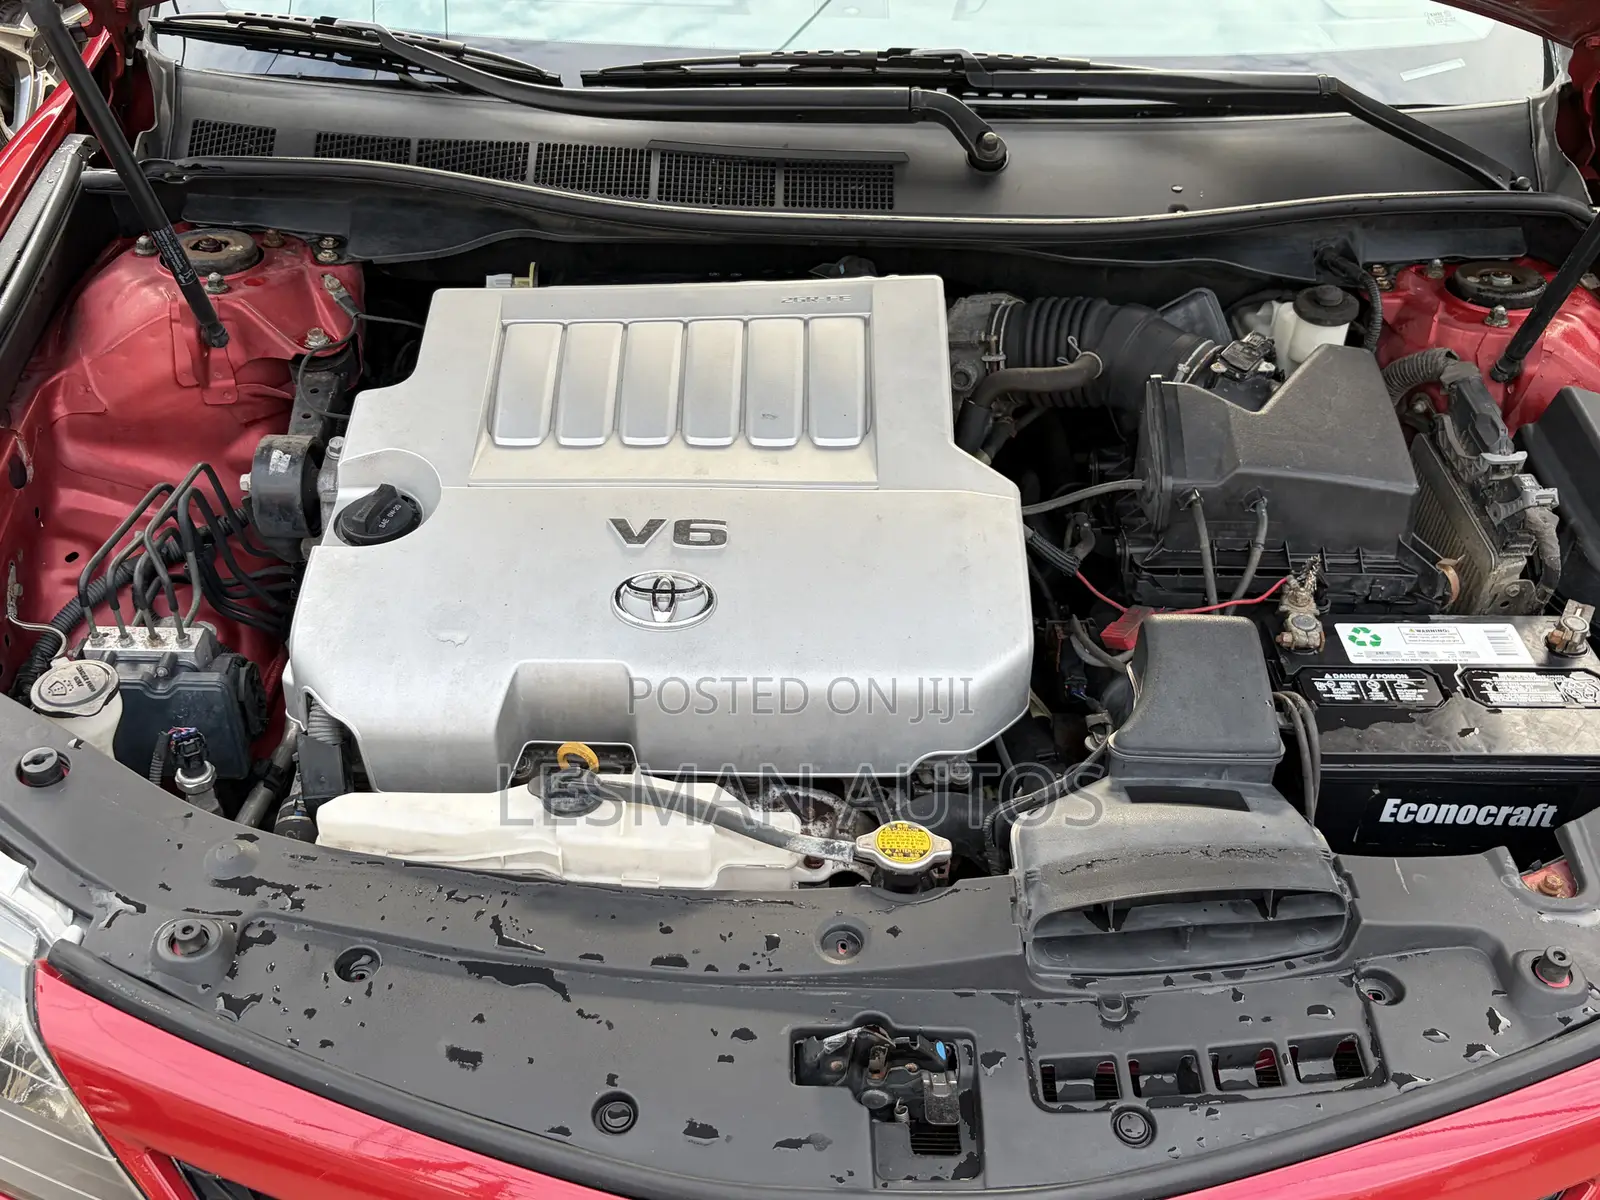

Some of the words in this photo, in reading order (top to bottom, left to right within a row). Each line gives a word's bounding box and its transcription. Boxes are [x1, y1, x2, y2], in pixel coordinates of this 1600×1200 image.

[378, 519, 390, 529] SAE
[606, 517, 728, 549] V6
[1379, 798, 1558, 828] Econocraft
